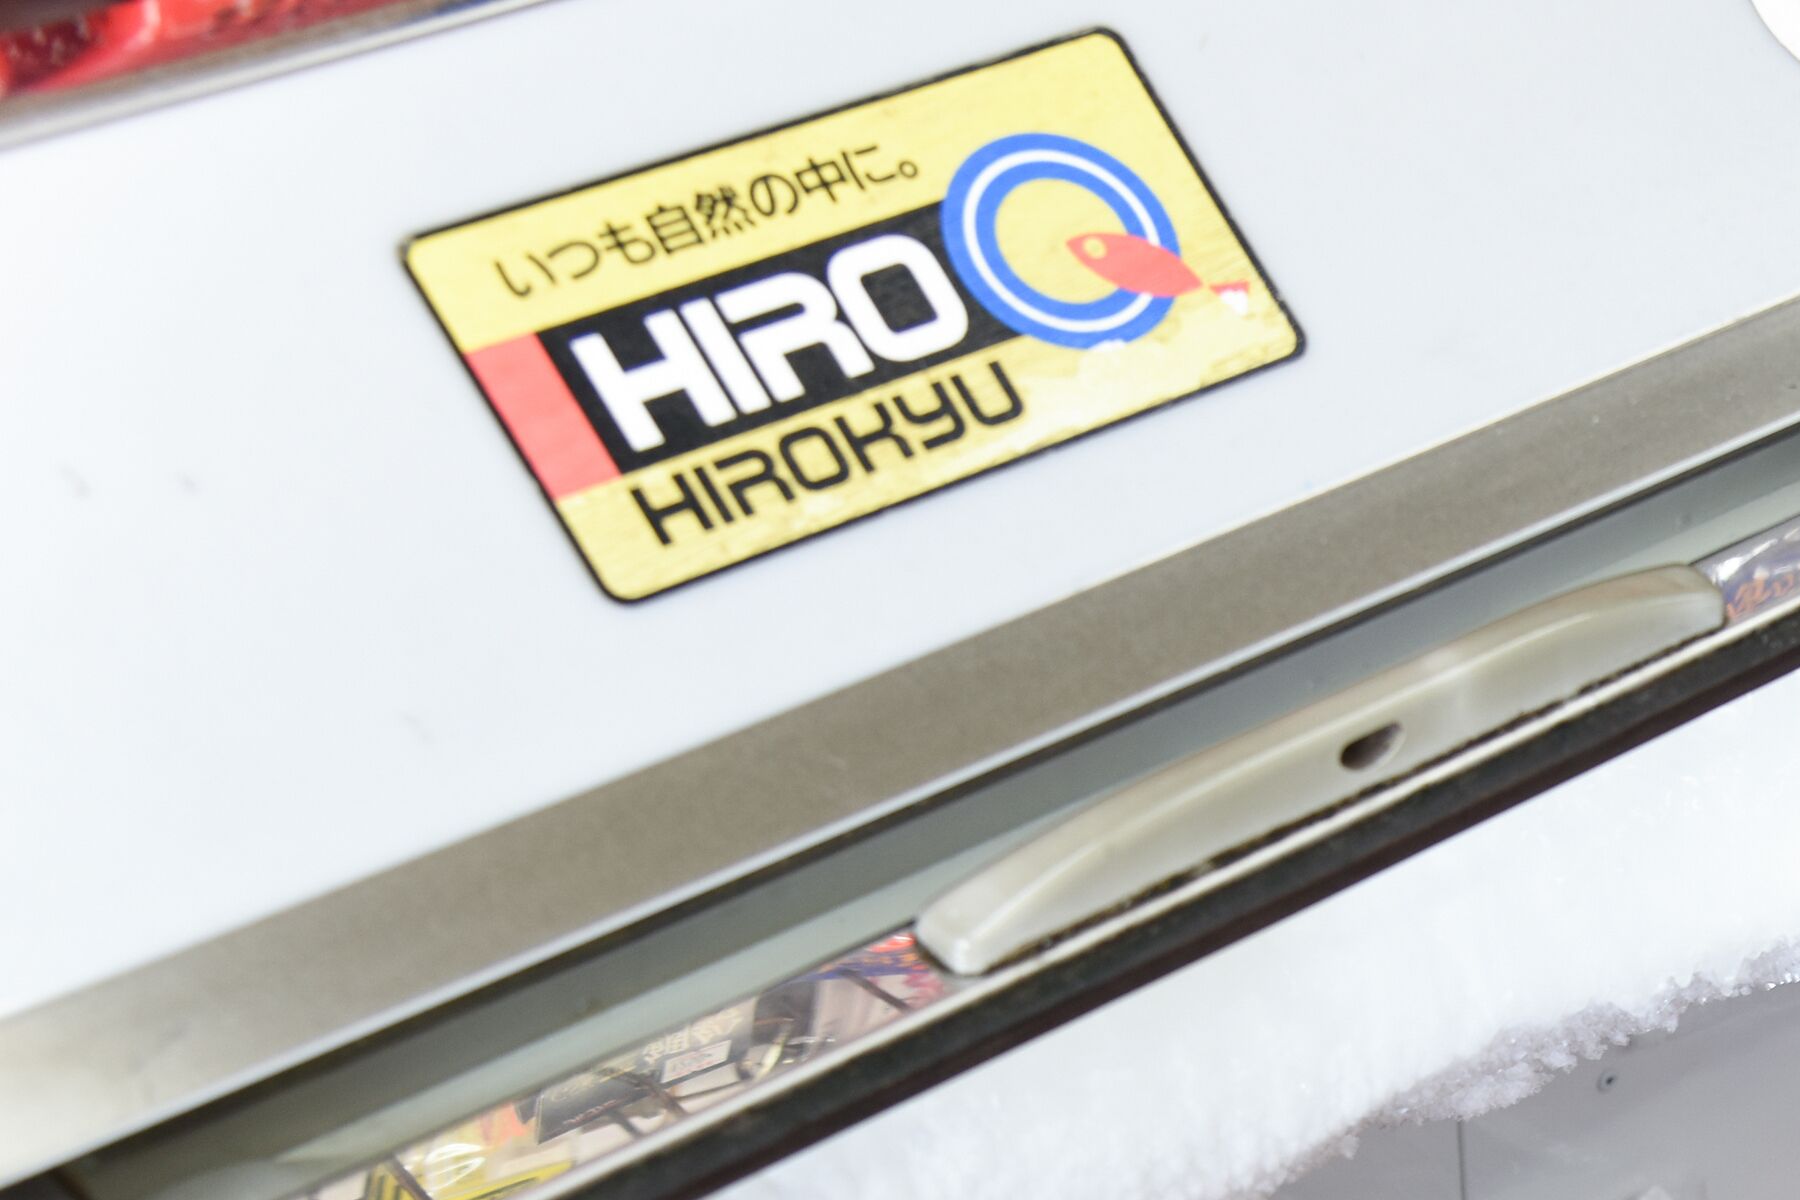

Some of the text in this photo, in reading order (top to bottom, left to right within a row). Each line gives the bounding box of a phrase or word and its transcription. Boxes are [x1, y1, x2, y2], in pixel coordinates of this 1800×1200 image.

[495, 143, 922, 298] いつも自然の中に。
[630, 361, 1024, 545] HIROKYU
